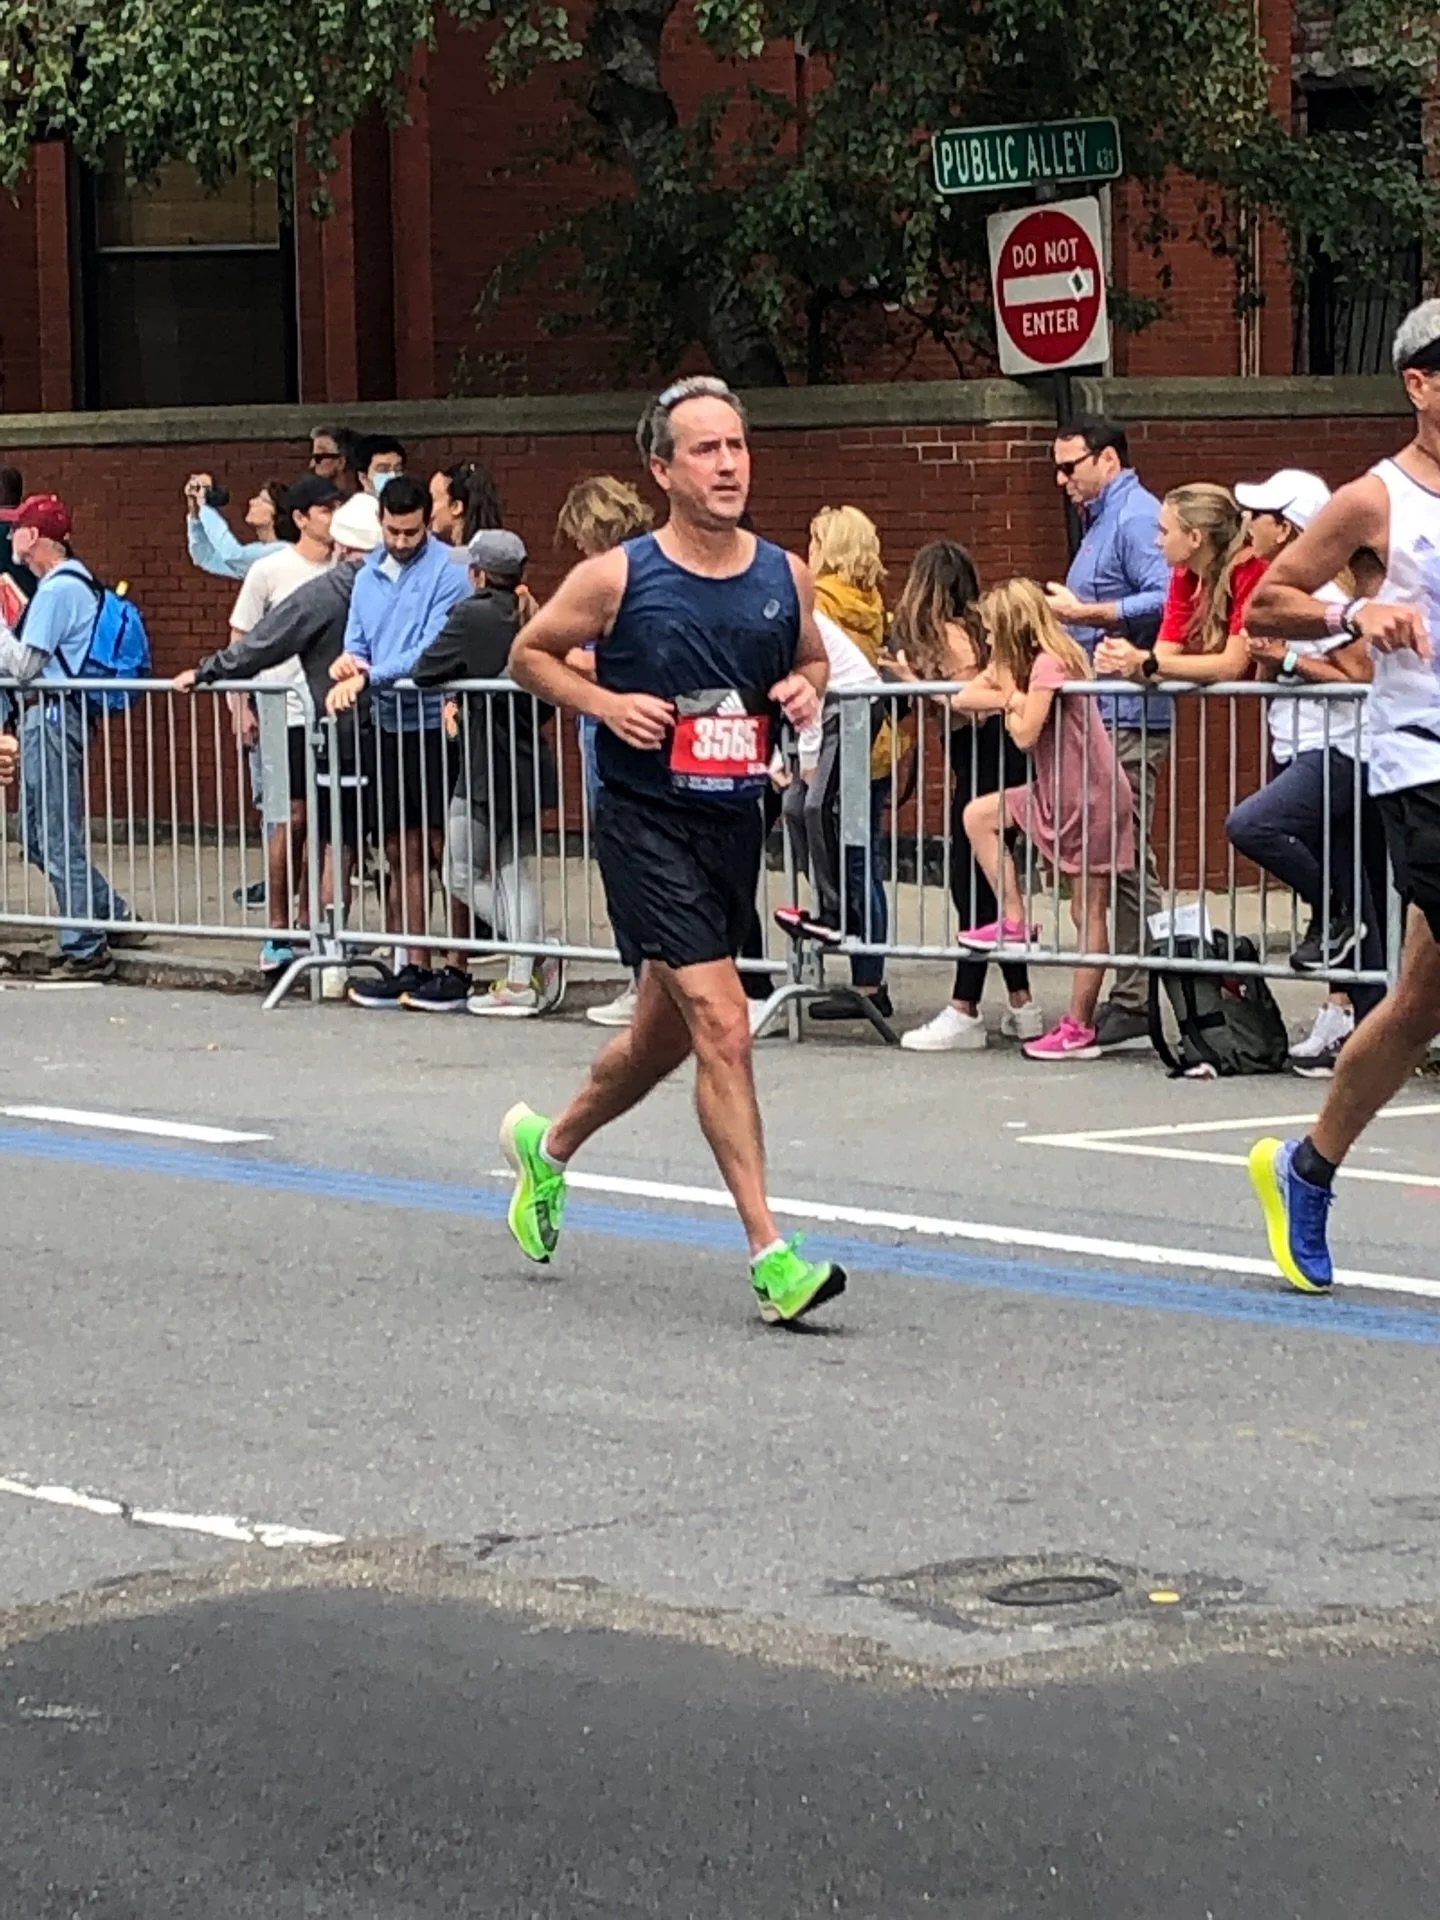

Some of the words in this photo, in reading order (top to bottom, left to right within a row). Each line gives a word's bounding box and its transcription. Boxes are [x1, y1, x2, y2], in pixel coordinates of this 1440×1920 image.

[940, 135, 1018, 186] PUBLIC
[1027, 130, 1087, 177] ALLEY
[1012, 244, 1037, 269] DO
[1044, 237, 1079, 264] NOT
[1022, 307, 1079, 337] ENTER
